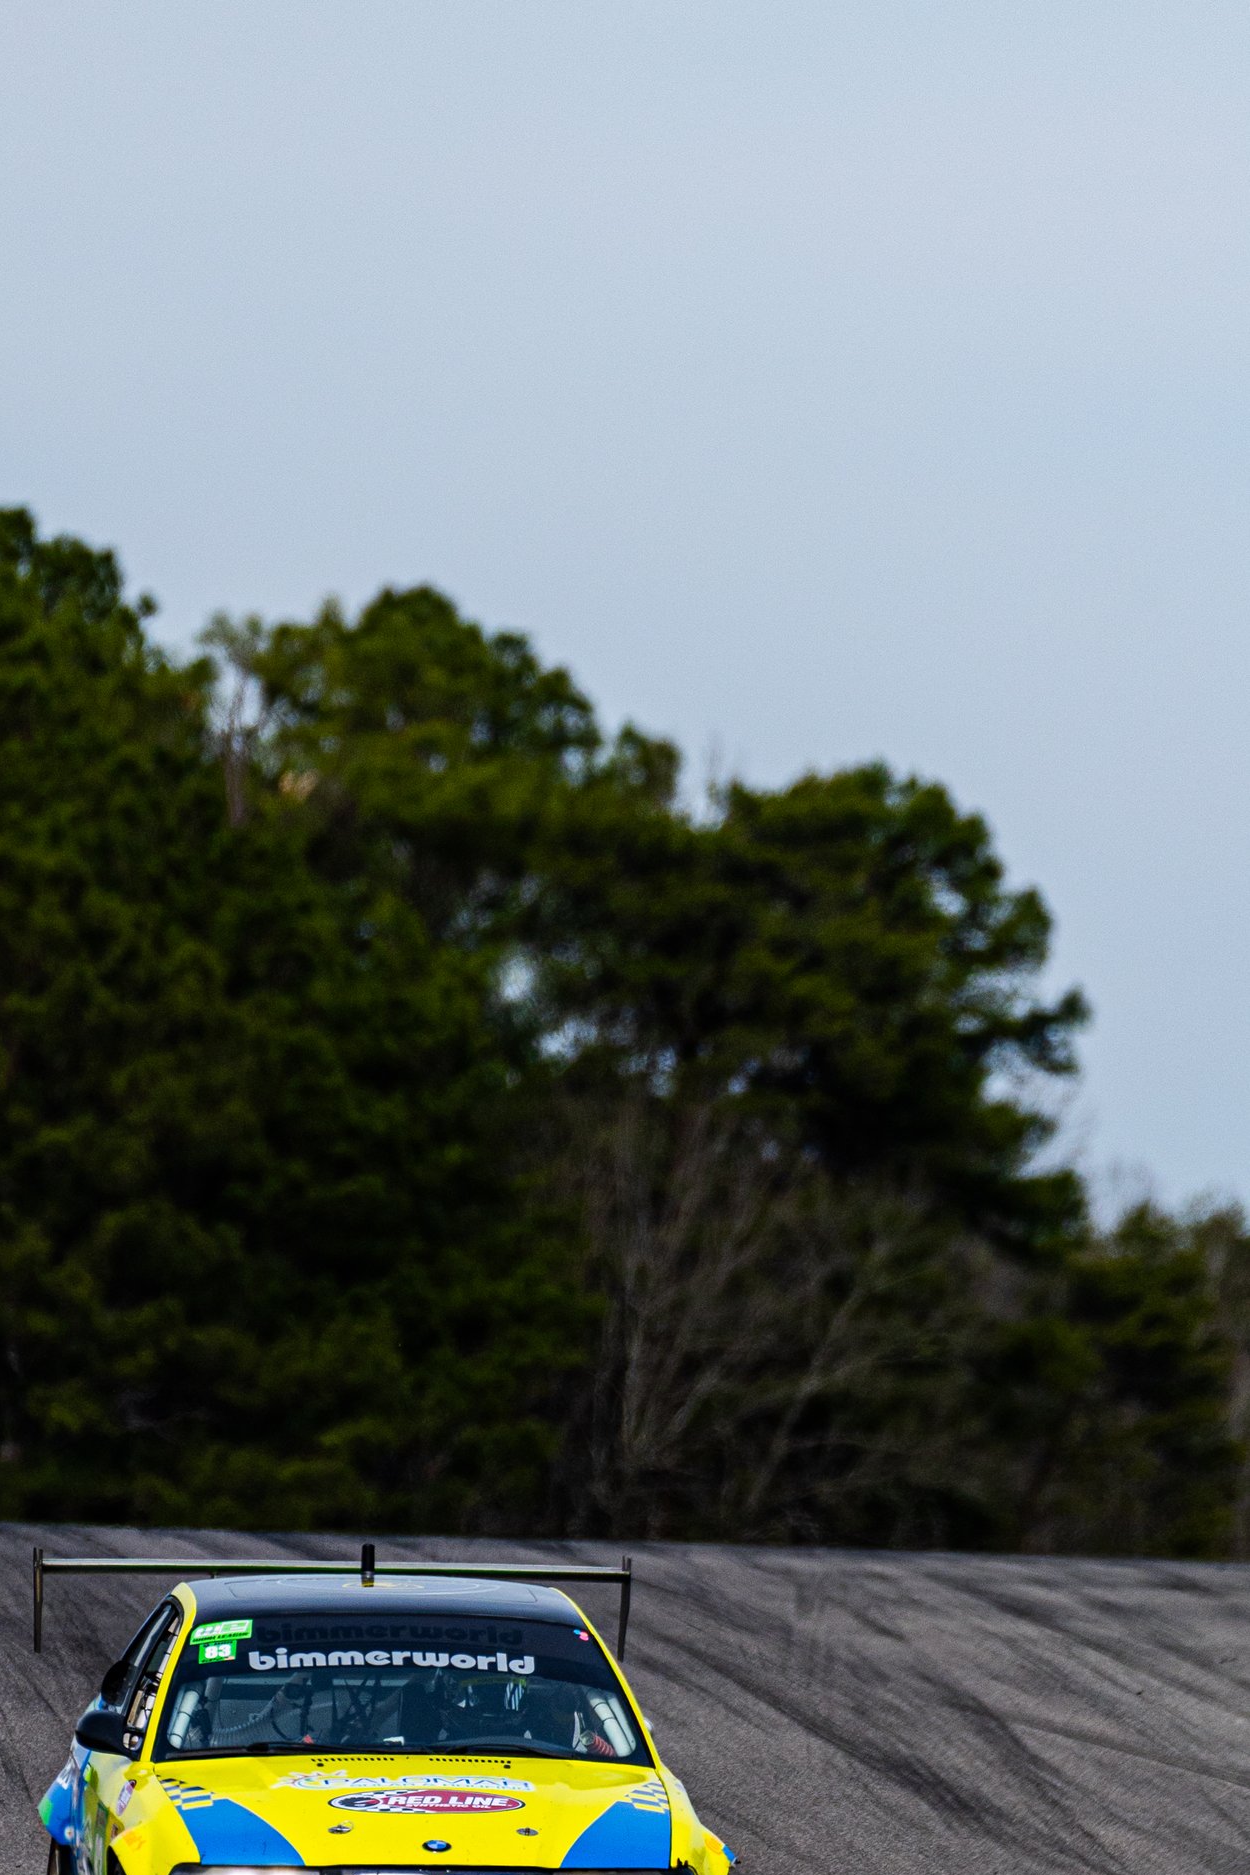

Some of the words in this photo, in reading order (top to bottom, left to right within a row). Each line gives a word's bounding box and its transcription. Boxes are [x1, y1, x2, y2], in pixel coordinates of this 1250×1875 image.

[204, 1643, 232, 1660] 83
[248, 1647, 536, 1675] bimmerworld
[388, 1795, 442, 1807] RED
[449, 1796, 509, 1807] LINE
